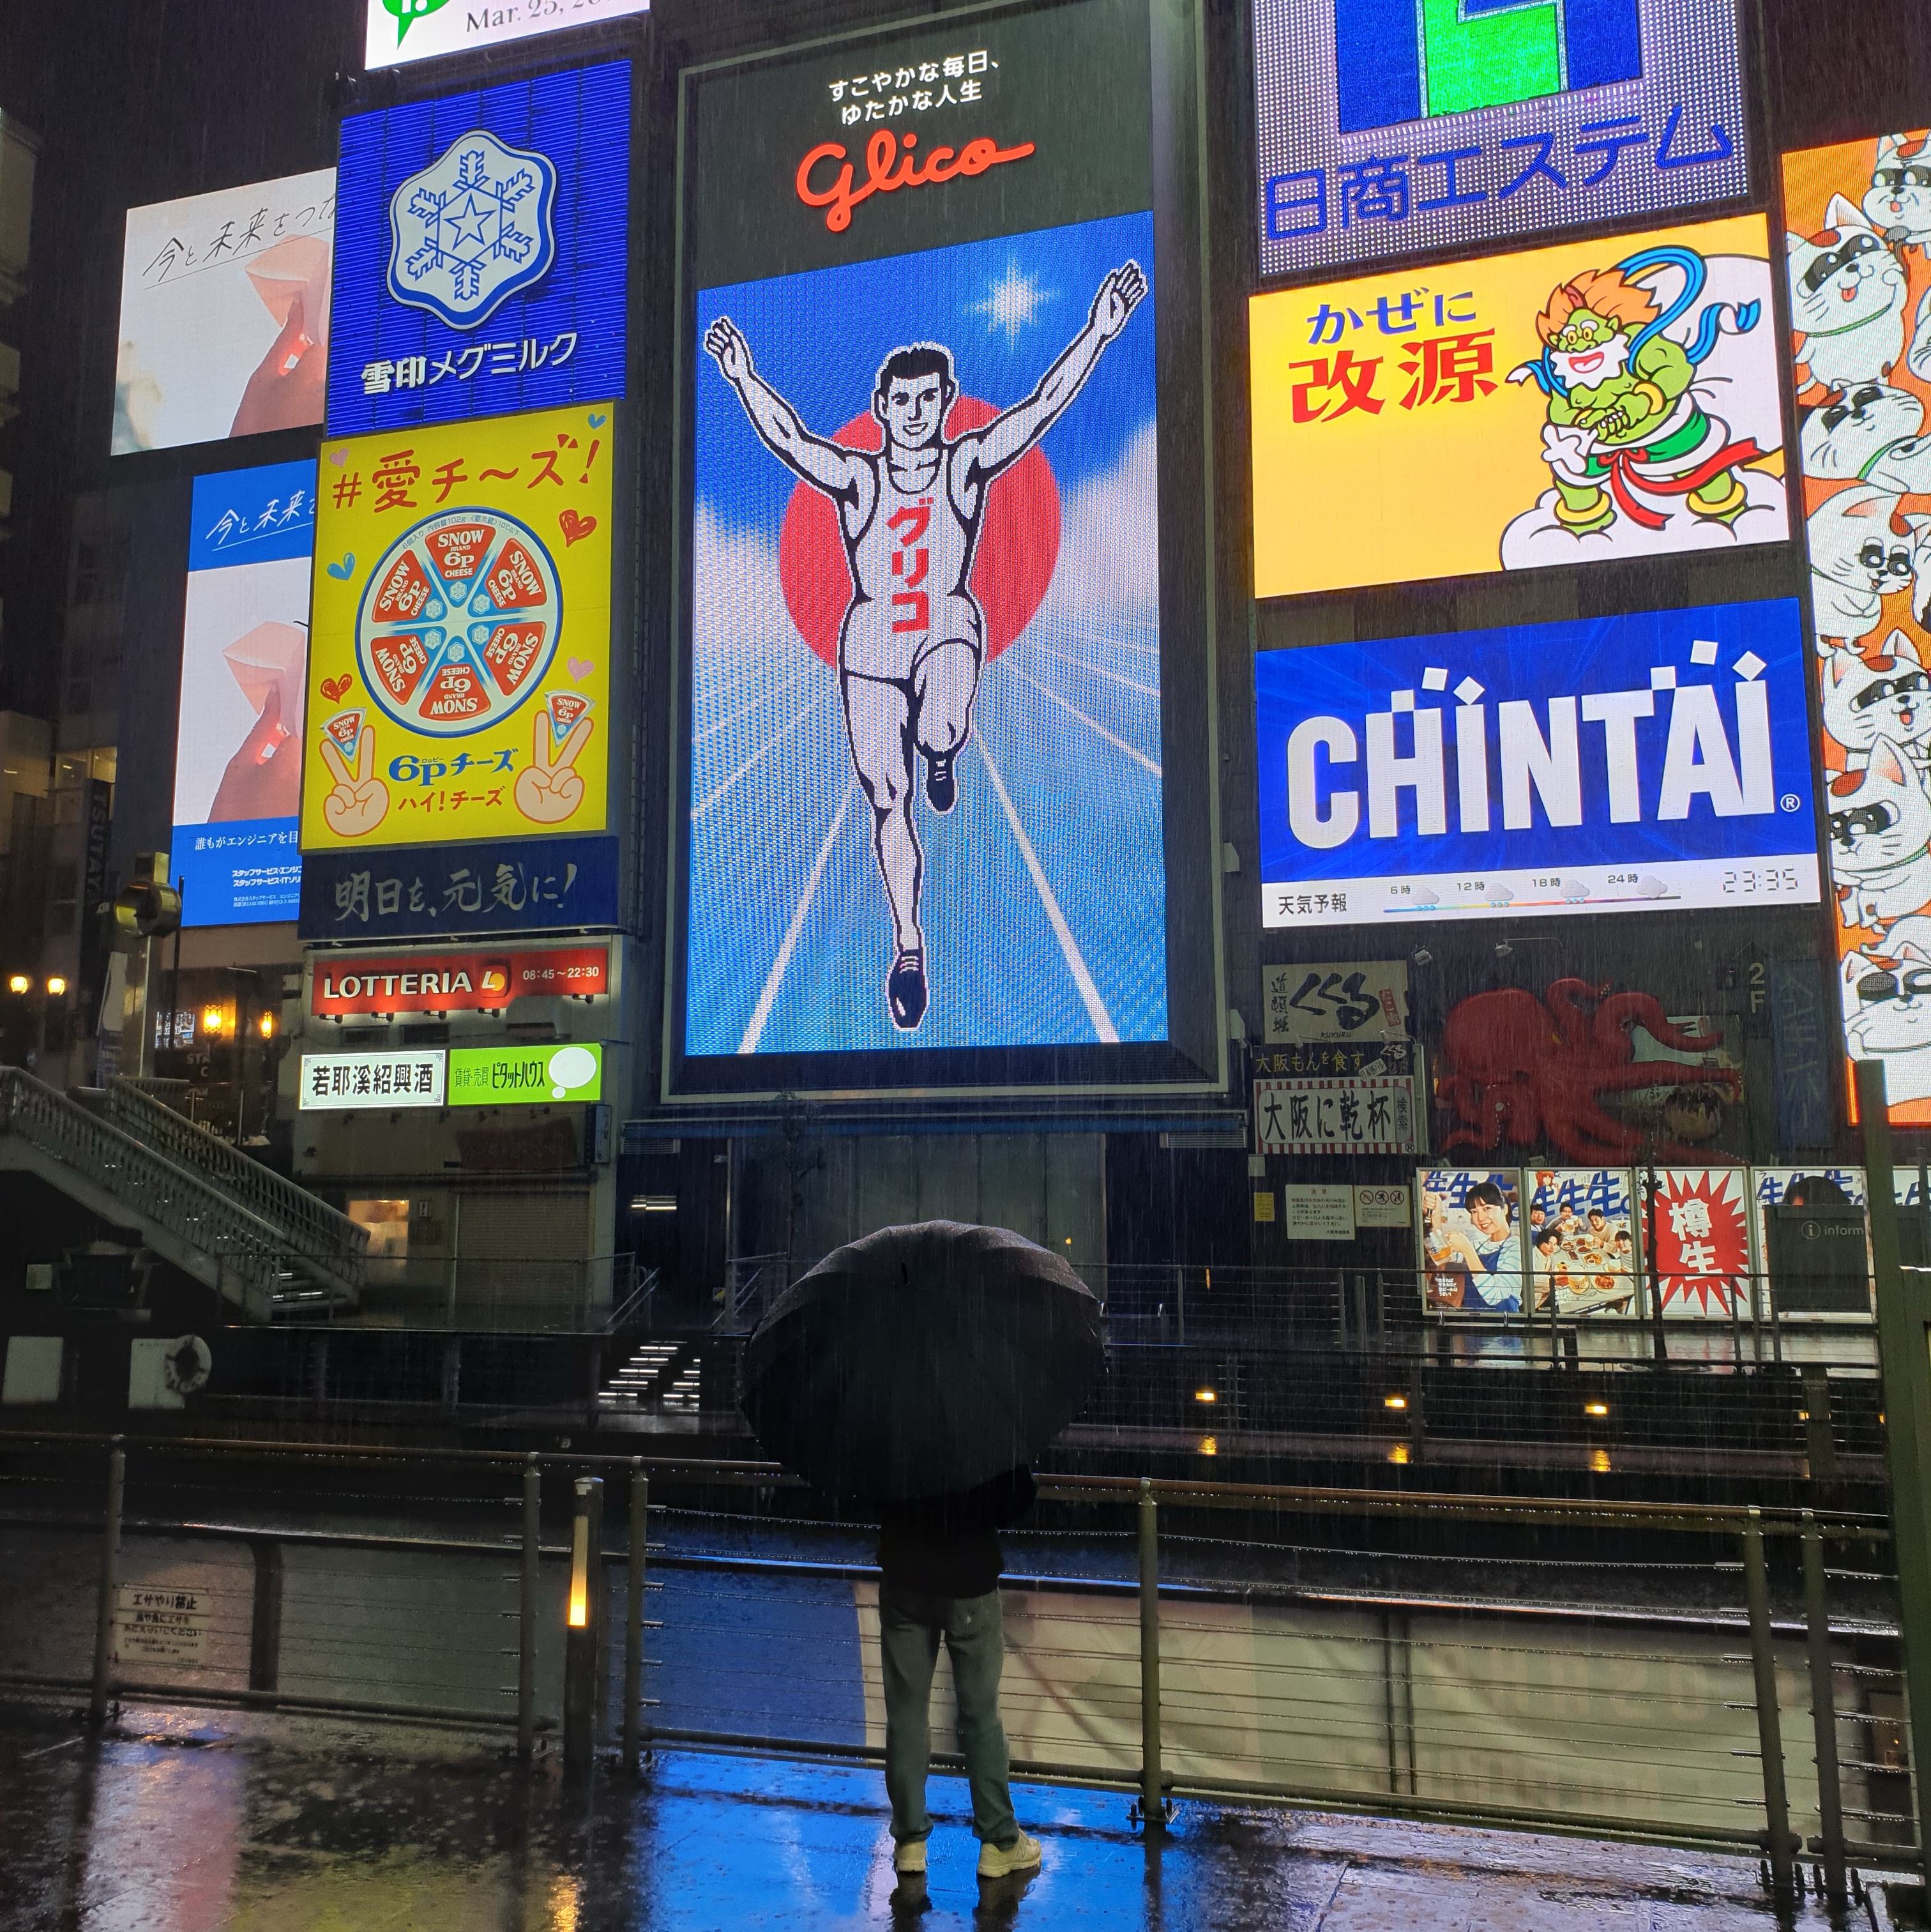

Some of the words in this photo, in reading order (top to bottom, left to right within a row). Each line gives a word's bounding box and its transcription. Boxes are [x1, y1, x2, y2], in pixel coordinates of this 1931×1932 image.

[466, 7, 520, 32] Mar.
[829, 50, 999, 102] すこやかな毎日、
[841, 80, 981, 126] ゆたかな人生
[796, 130, 1035, 232] Glico
[1266, 107, 1733, 240] 日商エステム
[1307, 287, 1476, 345] かぜに
[361, 333, 577, 395] 雪印メグミルク
[1289, 328, 1498, 423] 改源
[438, 529, 485, 547] SNOW
[445, 568, 473, 577] CHEESE
[509, 551, 542, 595] SNOW
[511, 569, 524, 589] BRAND
[886, 497, 934, 633] グリコ
[379, 559, 410, 612] SNOW
[395, 580, 409, 601] BRAND
[488, 579, 506, 607] CHEESE
[411, 586, 430, 616] CHEESE
[409, 635, 427, 664] CHEESE
[486, 628, 504, 658] CHEESE
[508, 643, 522, 665] BRAND
[375, 648, 406, 692] SNOW
[393, 654, 405, 674] BRAND
[442, 667, 470, 676] CHEESE
[506, 632, 539, 685] SNOW
[430, 697, 478, 715] SNOW
[557, 698, 581, 709] SNOW
[333, 715, 355, 730] SNOW
[195, 831, 298, 851] 誰もがエンジニアを目
[335, 862, 577, 922] 明日を、元気に!
[1278, 893, 1347, 915] 天気予報
[1391, 885, 1411, 894] 6時
[1457, 881, 1485, 892] 12時
[1533, 878, 1561, 888] 18時
[1608, 874, 1638, 884] 24時
[1721, 869, 1798, 893] 23:35
[324, 971, 472, 999] LOTTERIA
[1271, 972, 1289, 1033] 道頓堀
[1289, 972, 1379, 1030] くくる
[492, 1061, 545, 1088] ピタットハウス
[1256, 1049, 1365, 1073] 大阪もんを食す
[1264, 1090, 1390, 1141] 大阪に乾杯
[1668, 1198, 1723, 1281] 樽生
